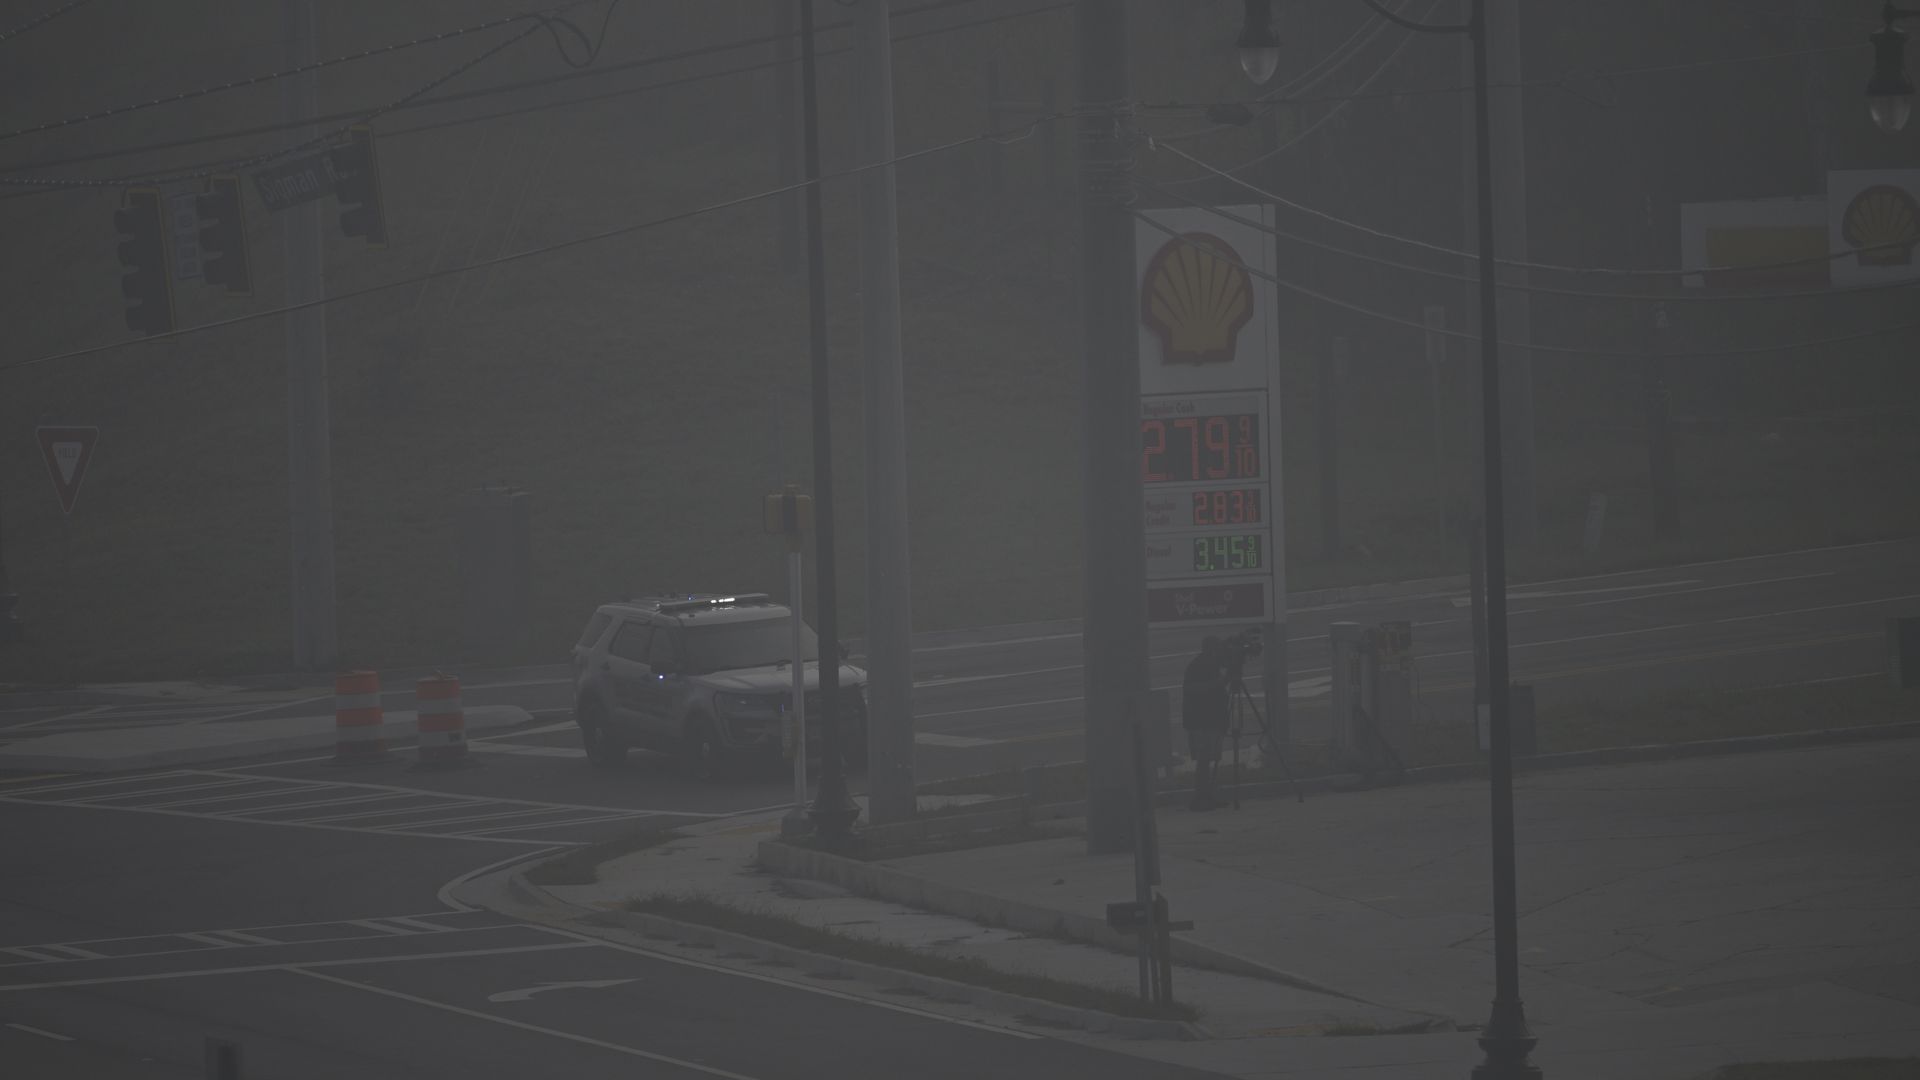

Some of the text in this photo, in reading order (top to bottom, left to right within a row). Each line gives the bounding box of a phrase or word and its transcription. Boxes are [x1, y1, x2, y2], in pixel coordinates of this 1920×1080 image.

[259, 170, 320, 205] Sigman
[1175, 399, 1195, 415] Cash
[1141, 416, 1229, 482] 2.79
[1194, 490, 1245, 525] 2.83
[1196, 535, 1244, 570] 3.45
[1176, 603, 1227, 617] V-Power
